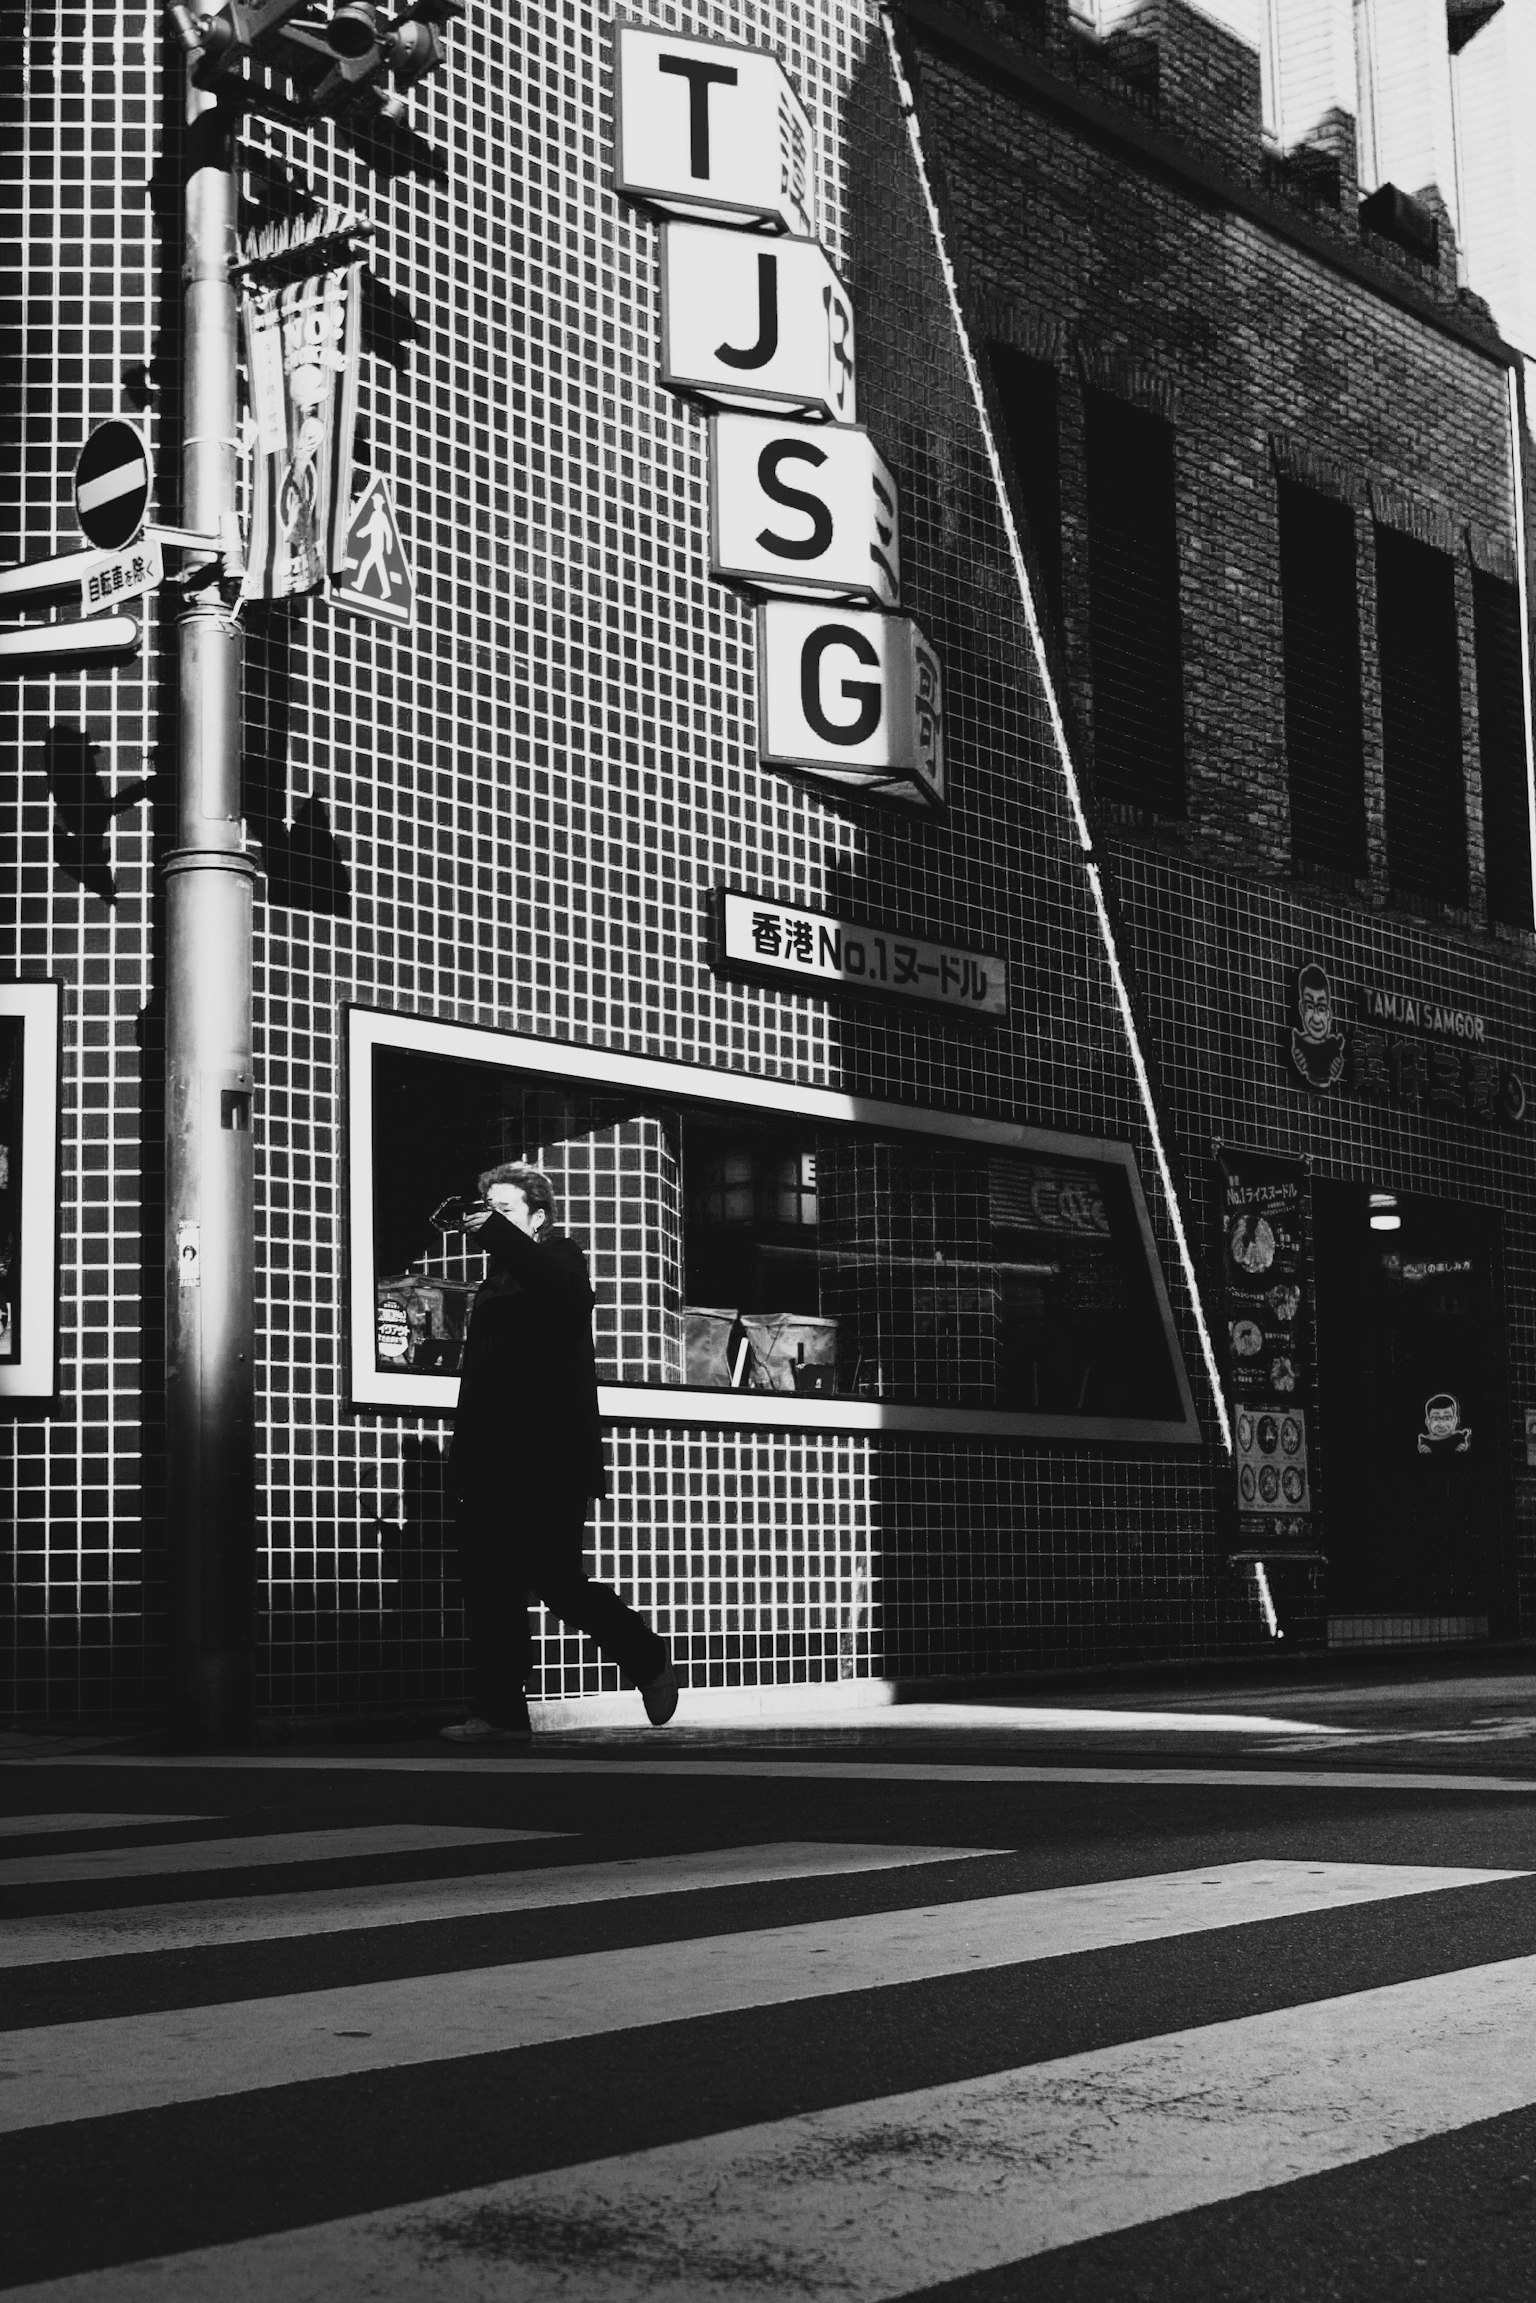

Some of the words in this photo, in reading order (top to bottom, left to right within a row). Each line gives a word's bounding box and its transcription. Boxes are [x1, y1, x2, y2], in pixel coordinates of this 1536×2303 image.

[658, 53, 738, 180] T
[713, 252, 777, 371] J
[755, 437, 834, 561] S
[88, 555, 154, 603] 自転車を除く
[800, 623, 883, 748] G
[752, 911, 987, 1002] 香港No.1ヌードル
[1363, 988, 1420, 1027] TAMJAI
[1423, 1004, 1486, 1044] SAMGOR
